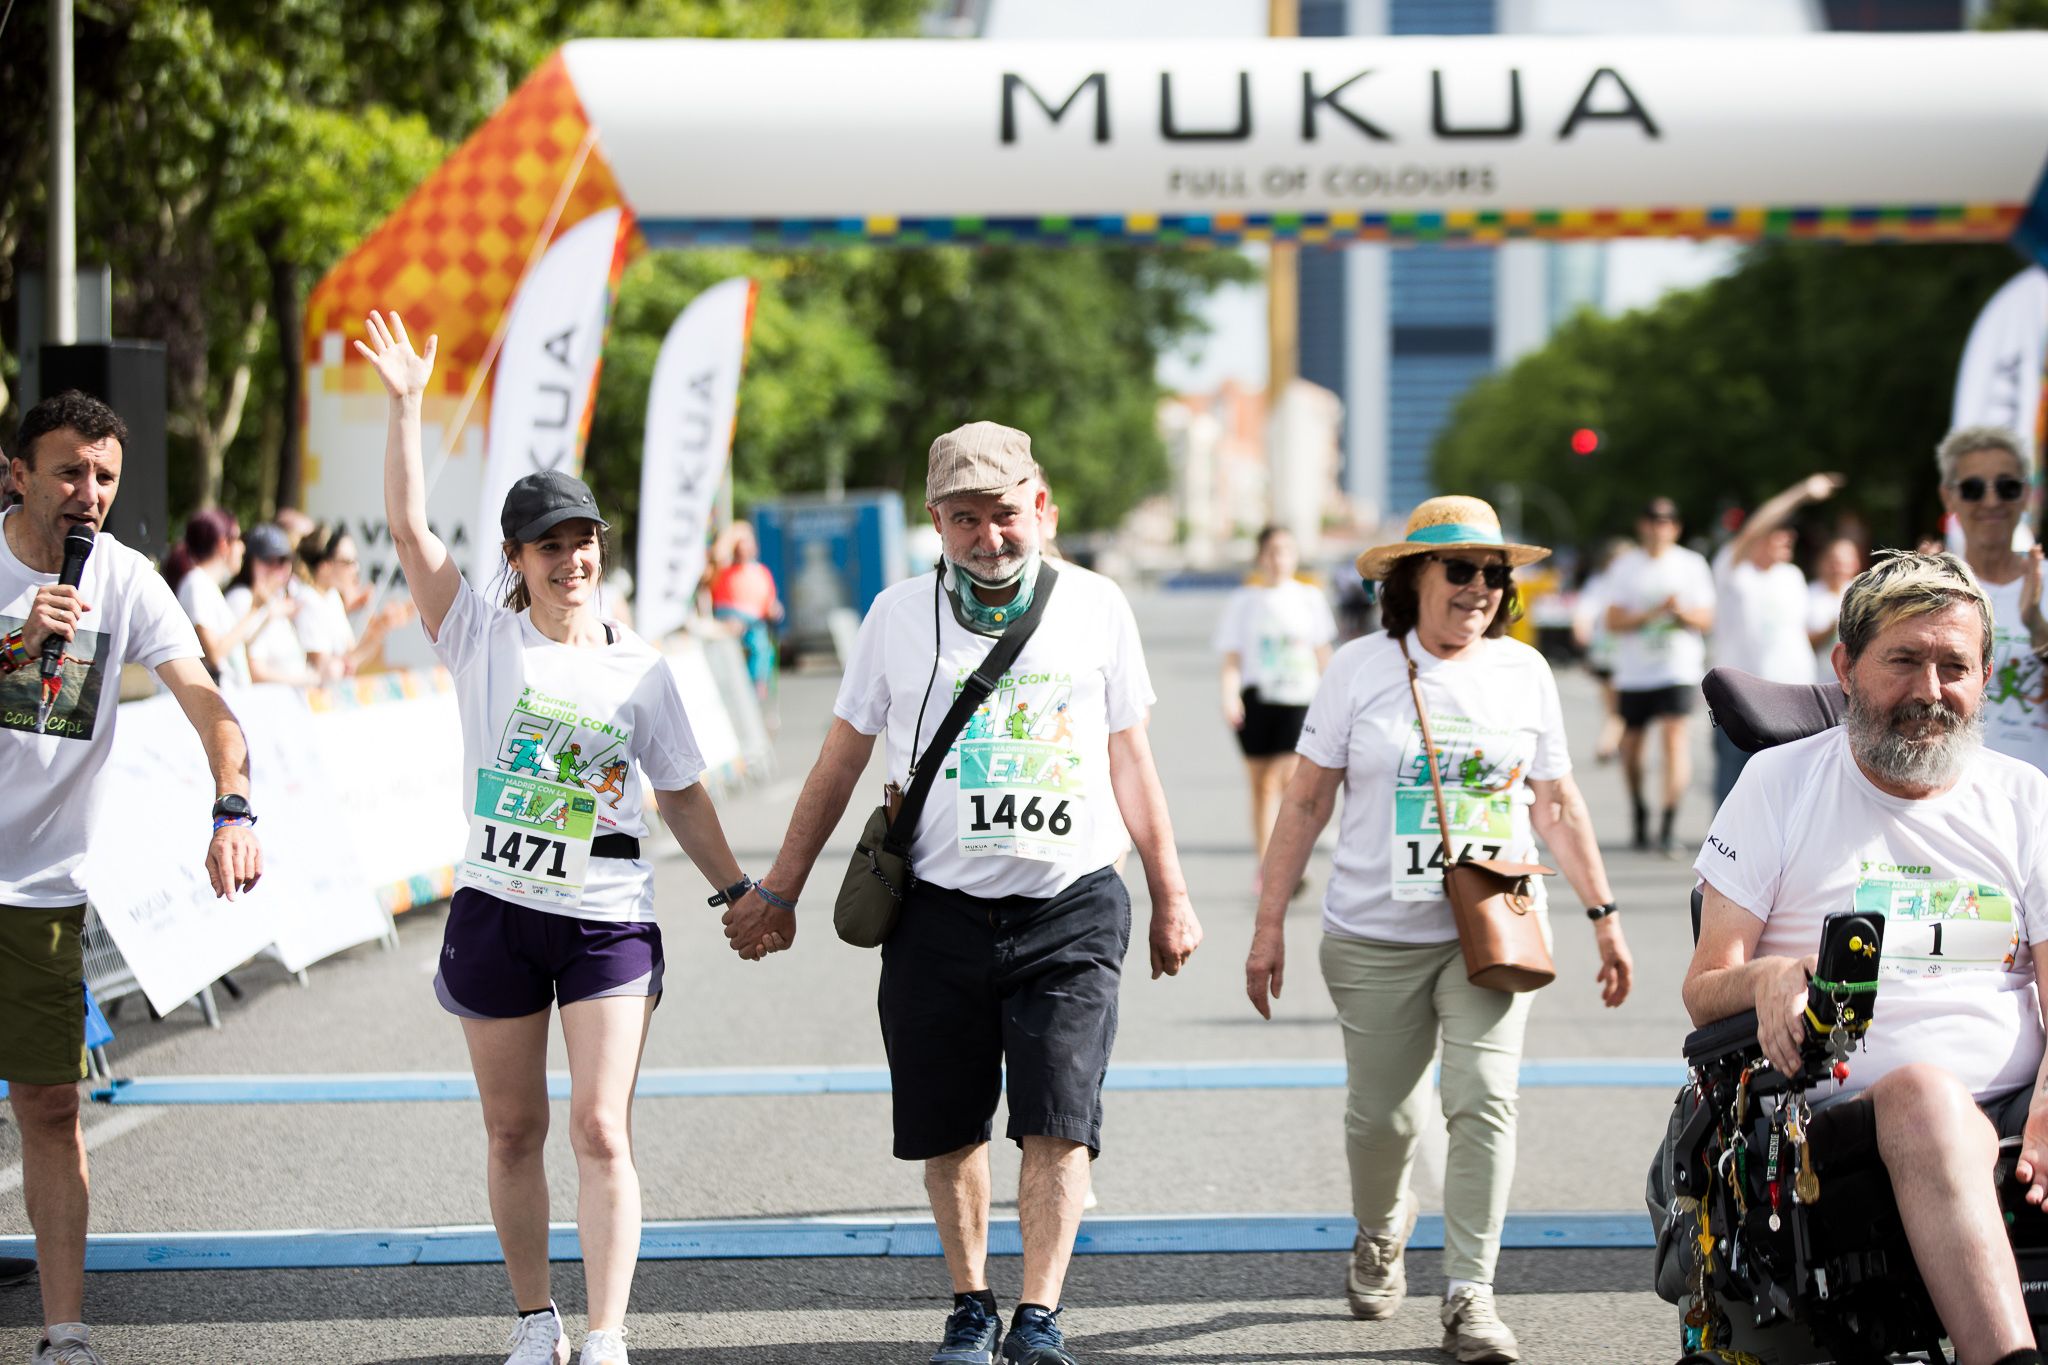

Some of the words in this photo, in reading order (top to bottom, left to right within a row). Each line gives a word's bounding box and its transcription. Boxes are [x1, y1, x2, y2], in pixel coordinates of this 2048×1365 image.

[998, 66, 1664, 145] MUKUA
[1168, 165, 1250, 196] FULL
[1261, 164, 1309, 194] OF
[1322, 164, 1496, 195] COLOURS
[529, 320, 577, 474] KUA
[1018, 673, 1050, 685] CON
[1054, 672, 1072, 683] LA
[536, 692, 578, 709] Carrera
[4, 711, 37, 727] con
[516, 697, 578, 723] MADRID
[580, 716, 613, 736] CON
[614, 727, 630, 742] LA
[985, 753, 1063, 787] ELA
[505, 778, 537, 790] MADRID
[537, 784, 555, 794] CON
[554, 790, 567, 798] LA
[495, 785, 569, 830] ELA
[970, 794, 1072, 836] 1466
[481, 824, 567, 879] 1471
[1707, 834, 1736, 862] KUA
[1878, 863, 1932, 874] Carrera
[1892, 881, 1931, 889] MADRID
[1889, 886, 1981, 920] ELA
[1928, 922, 1944, 956] 1
[1766, 1165, 1777, 1181] ELA
